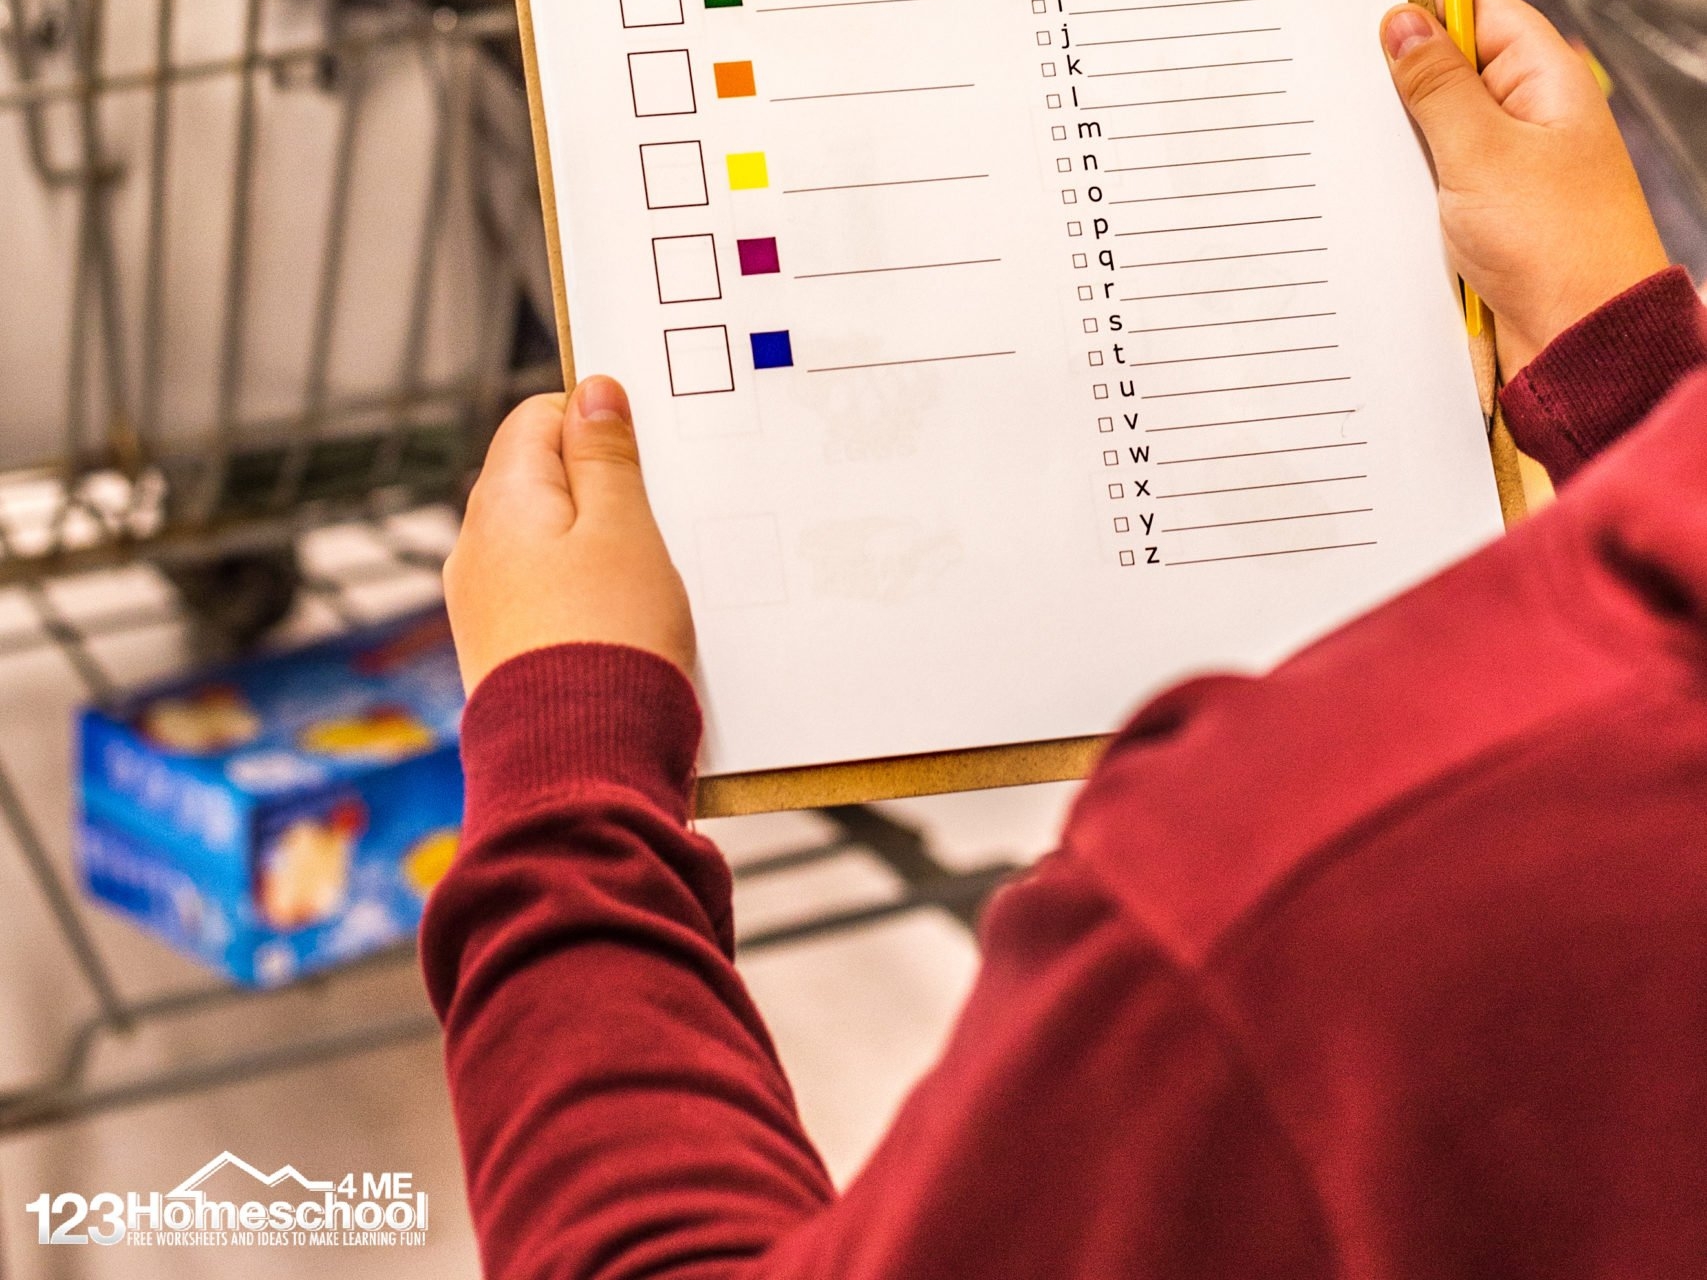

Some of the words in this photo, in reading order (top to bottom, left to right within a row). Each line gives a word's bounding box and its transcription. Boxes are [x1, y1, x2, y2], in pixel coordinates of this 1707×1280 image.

[1060, 23, 1071, 50] j
[1066, 54, 1083, 76] k
[1071, 85, 1079, 108] l
[1077, 121, 1102, 139] m
[1082, 154, 1098, 171] n
[1087, 186, 1103, 203] o
[1093, 217, 1109, 240] p
[1098, 249, 1115, 272] q
[1103, 281, 1115, 299] r
[1108, 314, 1123, 332] s
[1112, 343, 1126, 365] t
[1119, 380, 1135, 398] u
[1123, 412, 1139, 430] v
[1128, 445, 1150, 464] w
[1134, 479, 1151, 497] x
[1139, 512, 1155, 536] y
[1144, 546, 1161, 565] z
